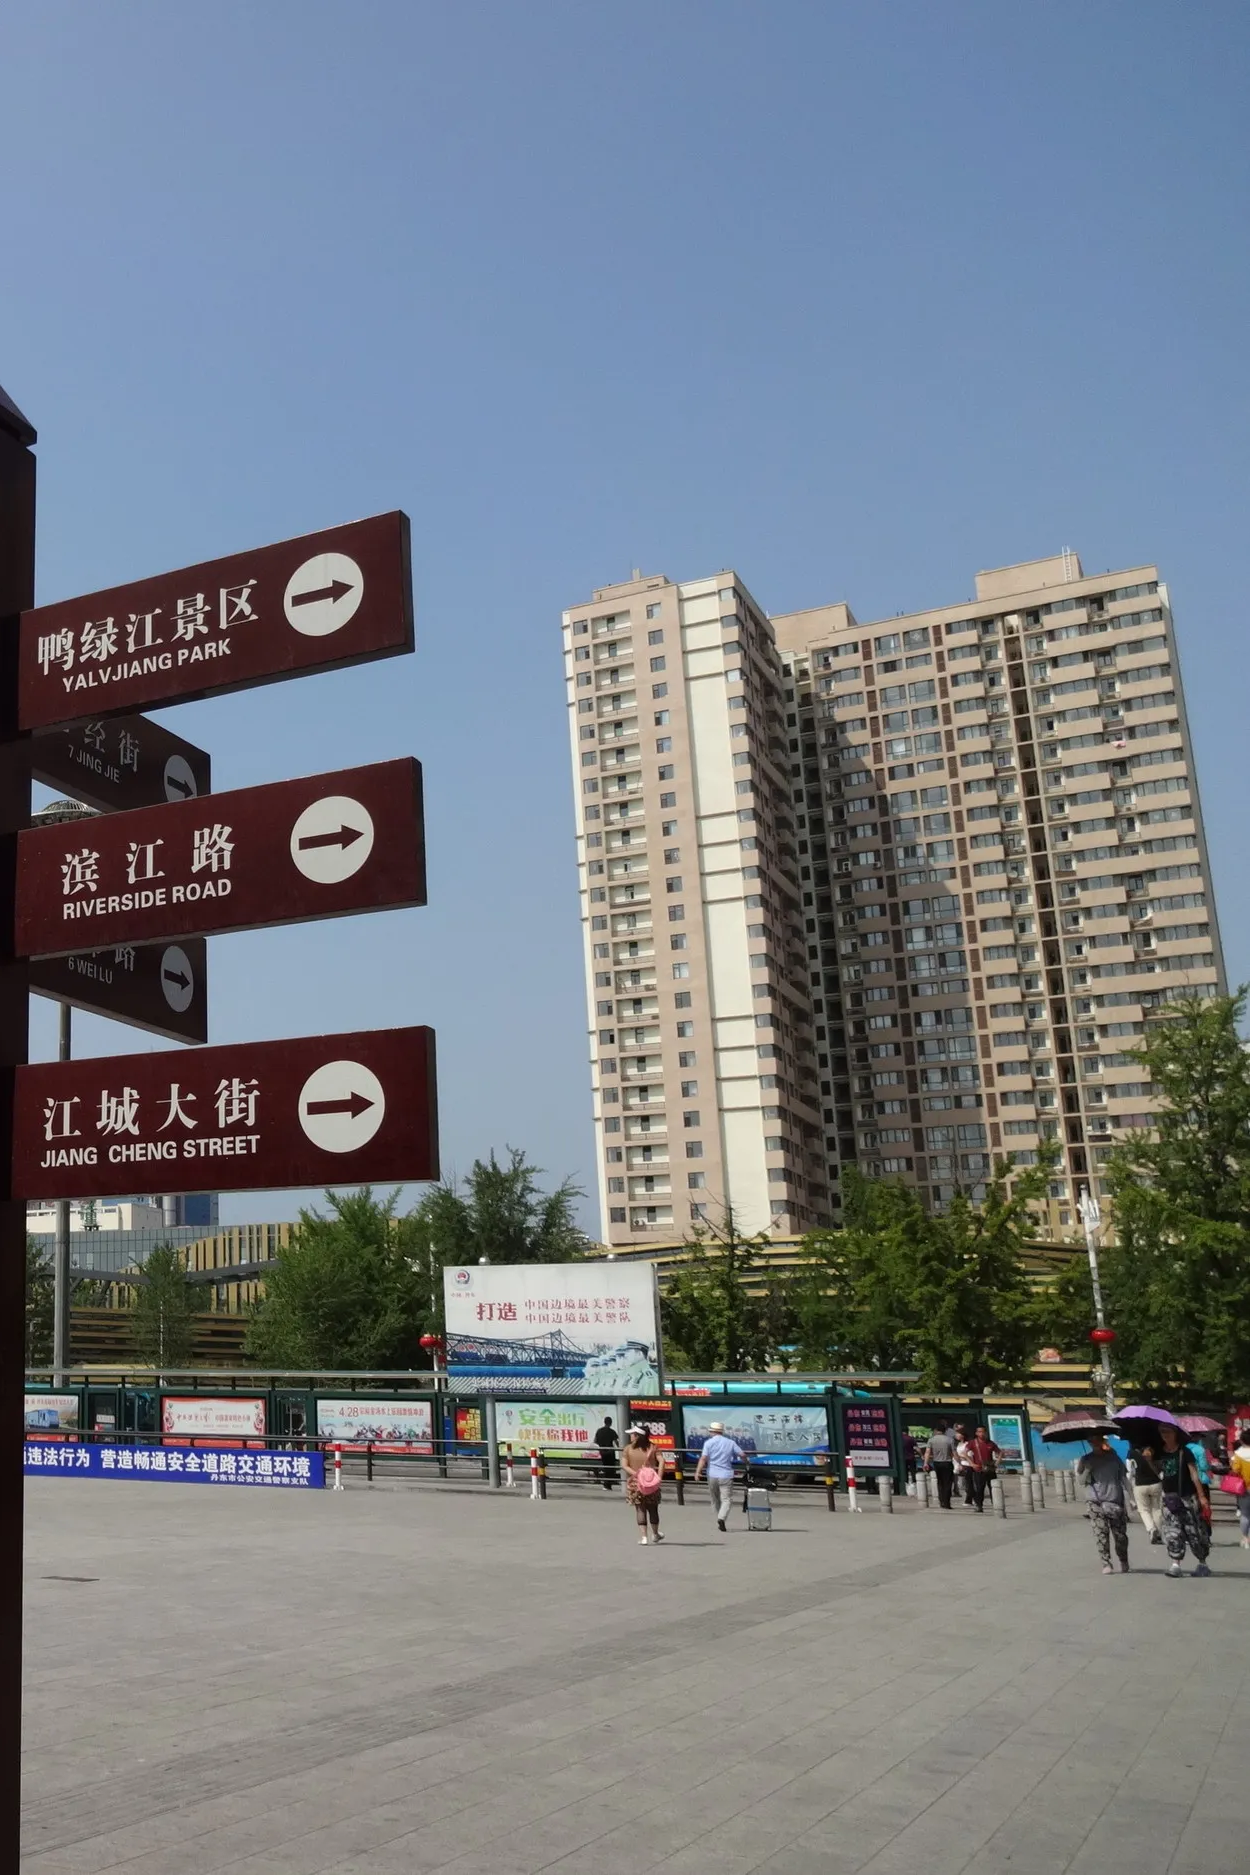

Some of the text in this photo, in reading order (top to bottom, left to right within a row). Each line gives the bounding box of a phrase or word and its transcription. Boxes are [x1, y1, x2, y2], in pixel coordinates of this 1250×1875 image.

[37, 578, 259, 676] 鸭绿江景区
[62, 637, 232, 694] YALVJIANG PARK
[62, 720, 140, 773] 经街
[76, 748, 102, 774] JING
[104, 764, 120, 784] JIE
[60, 823, 236, 896] 滨江路
[63, 878, 232, 921] RIVERSIDE ROAD
[68, 956, 75, 971] 6
[77, 959, 97, 979] WEI
[99, 967, 113, 985] LU
[43, 1077, 261, 1141] 江城大街
[40, 1134, 261, 1168] JIANG CHENG STREET
[476, 1302, 518, 1322] 打造
[519, 1408, 586, 1426] 安全出行
[24, 1445, 312, 1478] 违法行为 营造畅通安全道路交通环境
